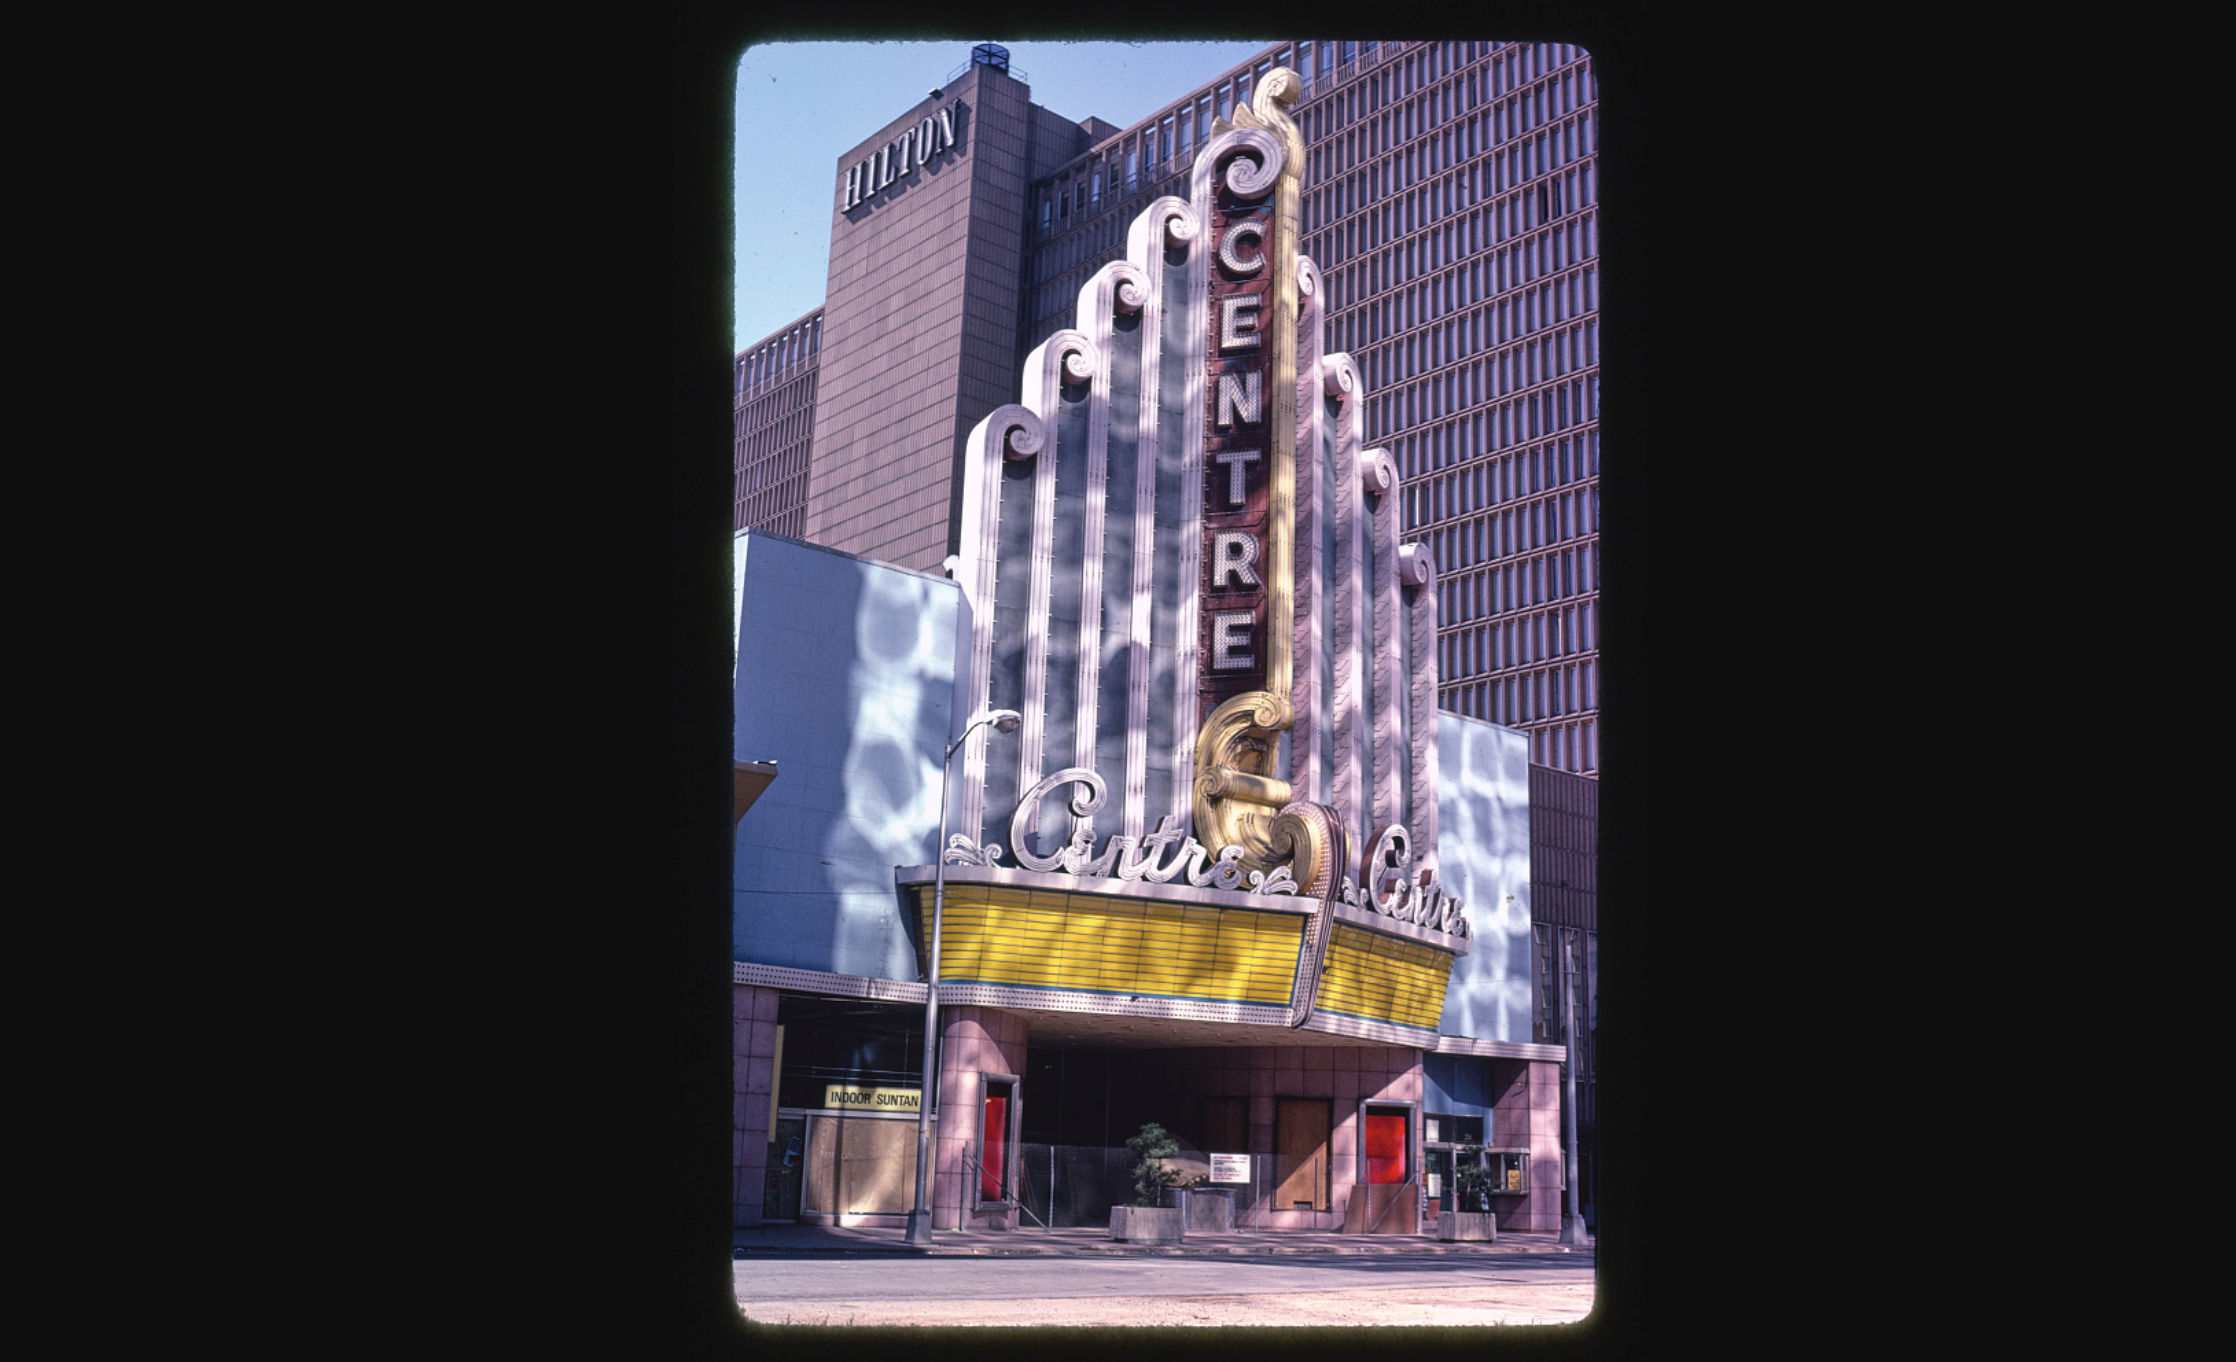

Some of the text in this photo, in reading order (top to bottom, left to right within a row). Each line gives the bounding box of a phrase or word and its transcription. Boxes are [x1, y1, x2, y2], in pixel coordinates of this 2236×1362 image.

[842, 98, 961, 214] HILTON
[1213, 218, 1268, 671] CENTRE
[1010, 768, 1244, 890] Centre
[1360, 824, 1465, 936] Centre
[830, 1091, 919, 1107] INDOOR SUNTAN
